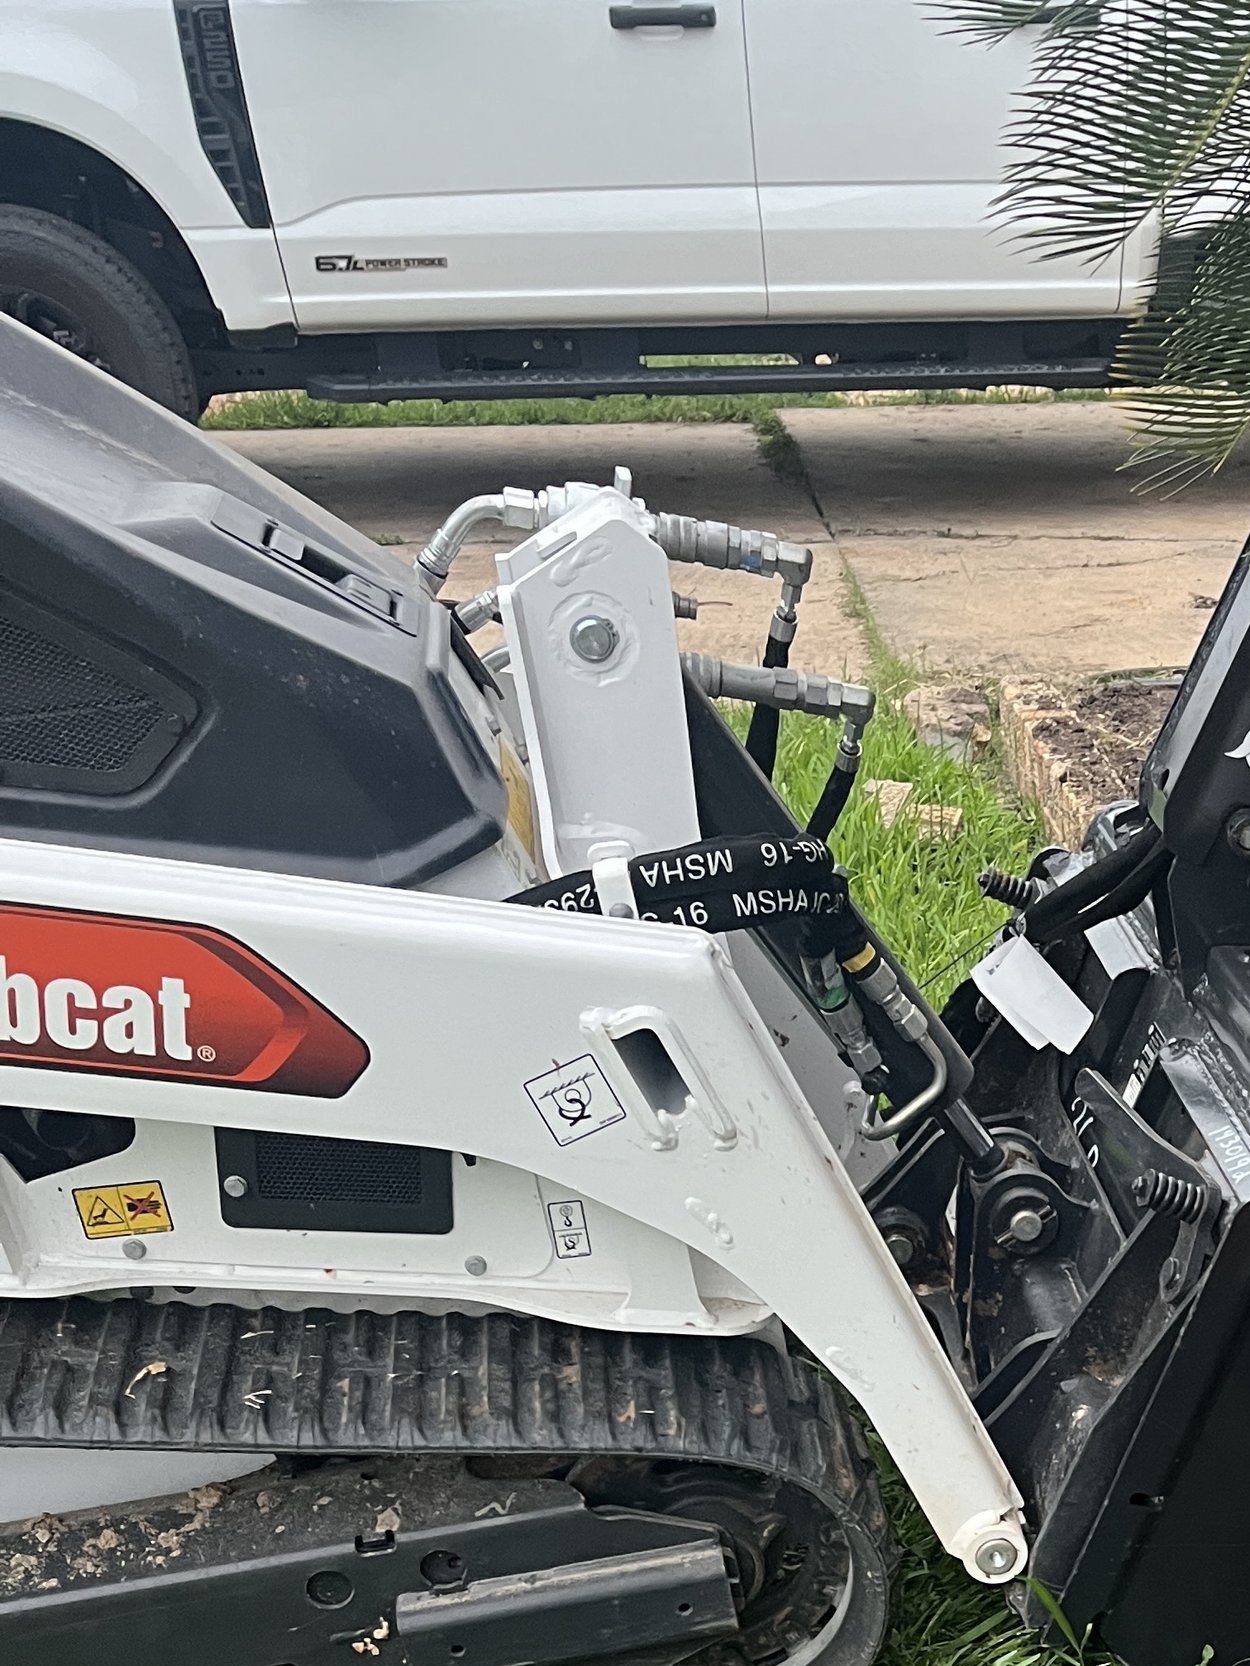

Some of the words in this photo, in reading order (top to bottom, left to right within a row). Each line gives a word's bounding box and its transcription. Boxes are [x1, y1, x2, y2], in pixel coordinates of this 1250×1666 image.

[315, 255, 365, 271] 6.7L
[365, 259, 402, 269] POWER
[403, 258, 447, 267] STROKE
[639, 849, 733, 887] MSHA
